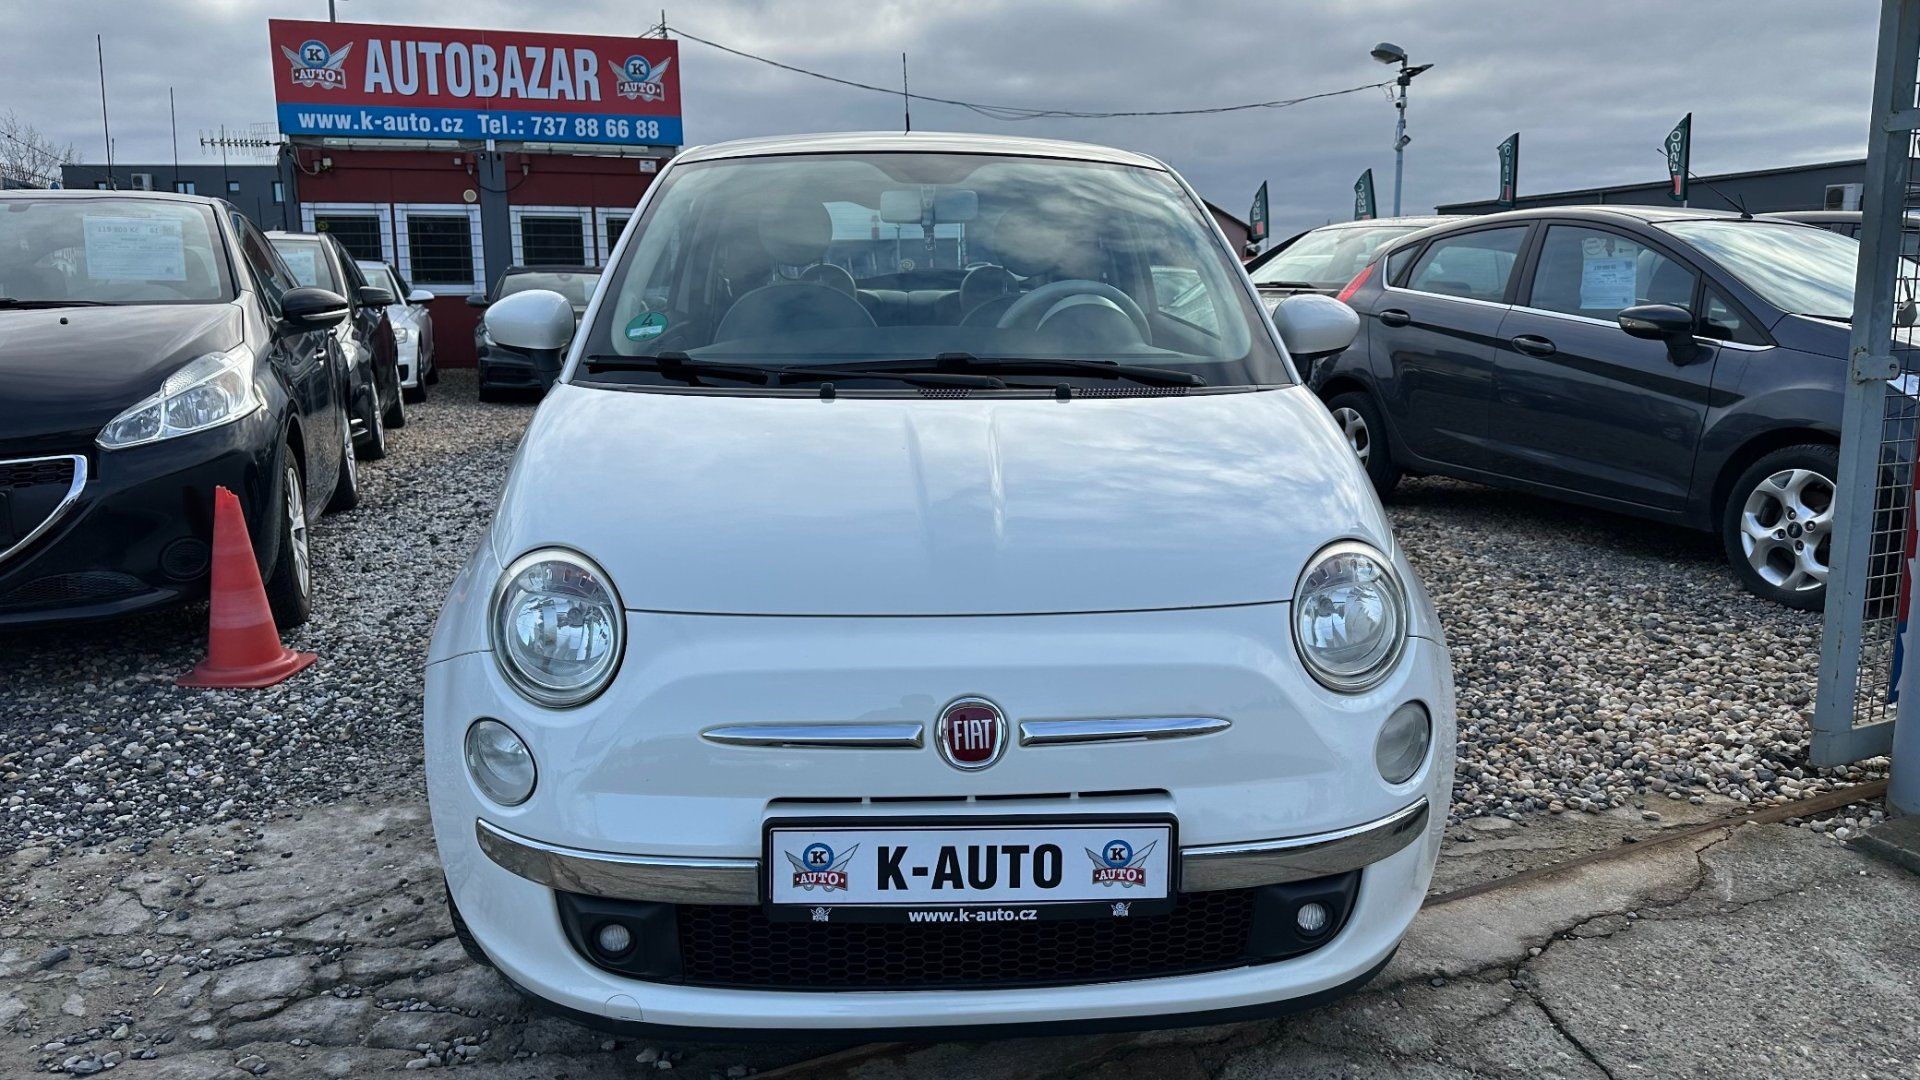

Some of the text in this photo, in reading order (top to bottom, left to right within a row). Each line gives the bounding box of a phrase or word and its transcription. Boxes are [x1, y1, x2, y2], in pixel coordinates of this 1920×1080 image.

[307, 48, 322, 61] K
[300, 68, 335, 82] AUTO
[364, 38, 602, 101] AUTOBAZAR
[631, 63, 644, 75] K
[624, 82, 655, 95] AUTO
[298, 111, 659, 139] www.k-auto.cz Tel.: 737 88 66 88
[953, 719, 992, 751] FIAT
[810, 851, 827, 864] K
[1110, 848, 1126, 861] K
[877, 844, 1063, 890] K-AUTO
[800, 872, 839, 885] AUTO
[1099, 869, 1137, 881] AUTO
[908, 908, 1038, 922] www.k-auto.cz
